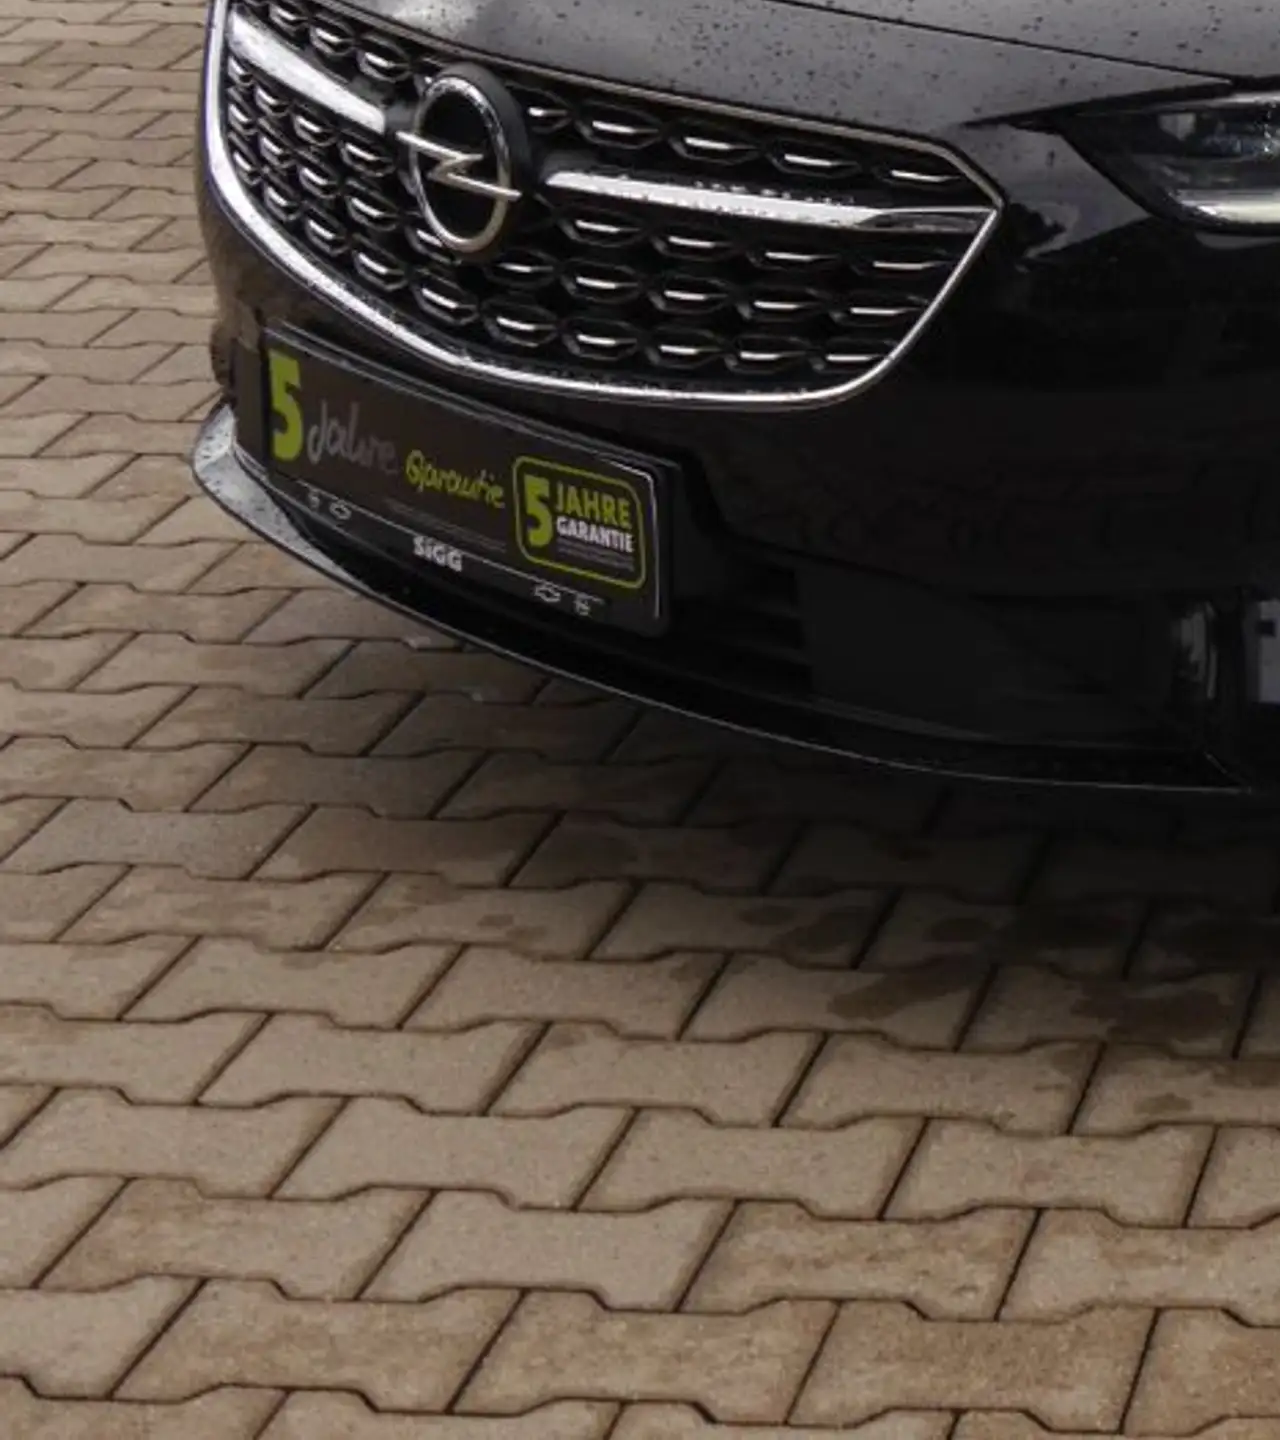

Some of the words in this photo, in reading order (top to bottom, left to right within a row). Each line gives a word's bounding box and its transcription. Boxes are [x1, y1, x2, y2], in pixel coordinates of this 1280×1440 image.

[269, 349, 303, 459] 5
[524, 474, 553, 547] 5
[556, 483, 632, 530] JAHRE
[556, 517, 635, 553] GARANTIE
